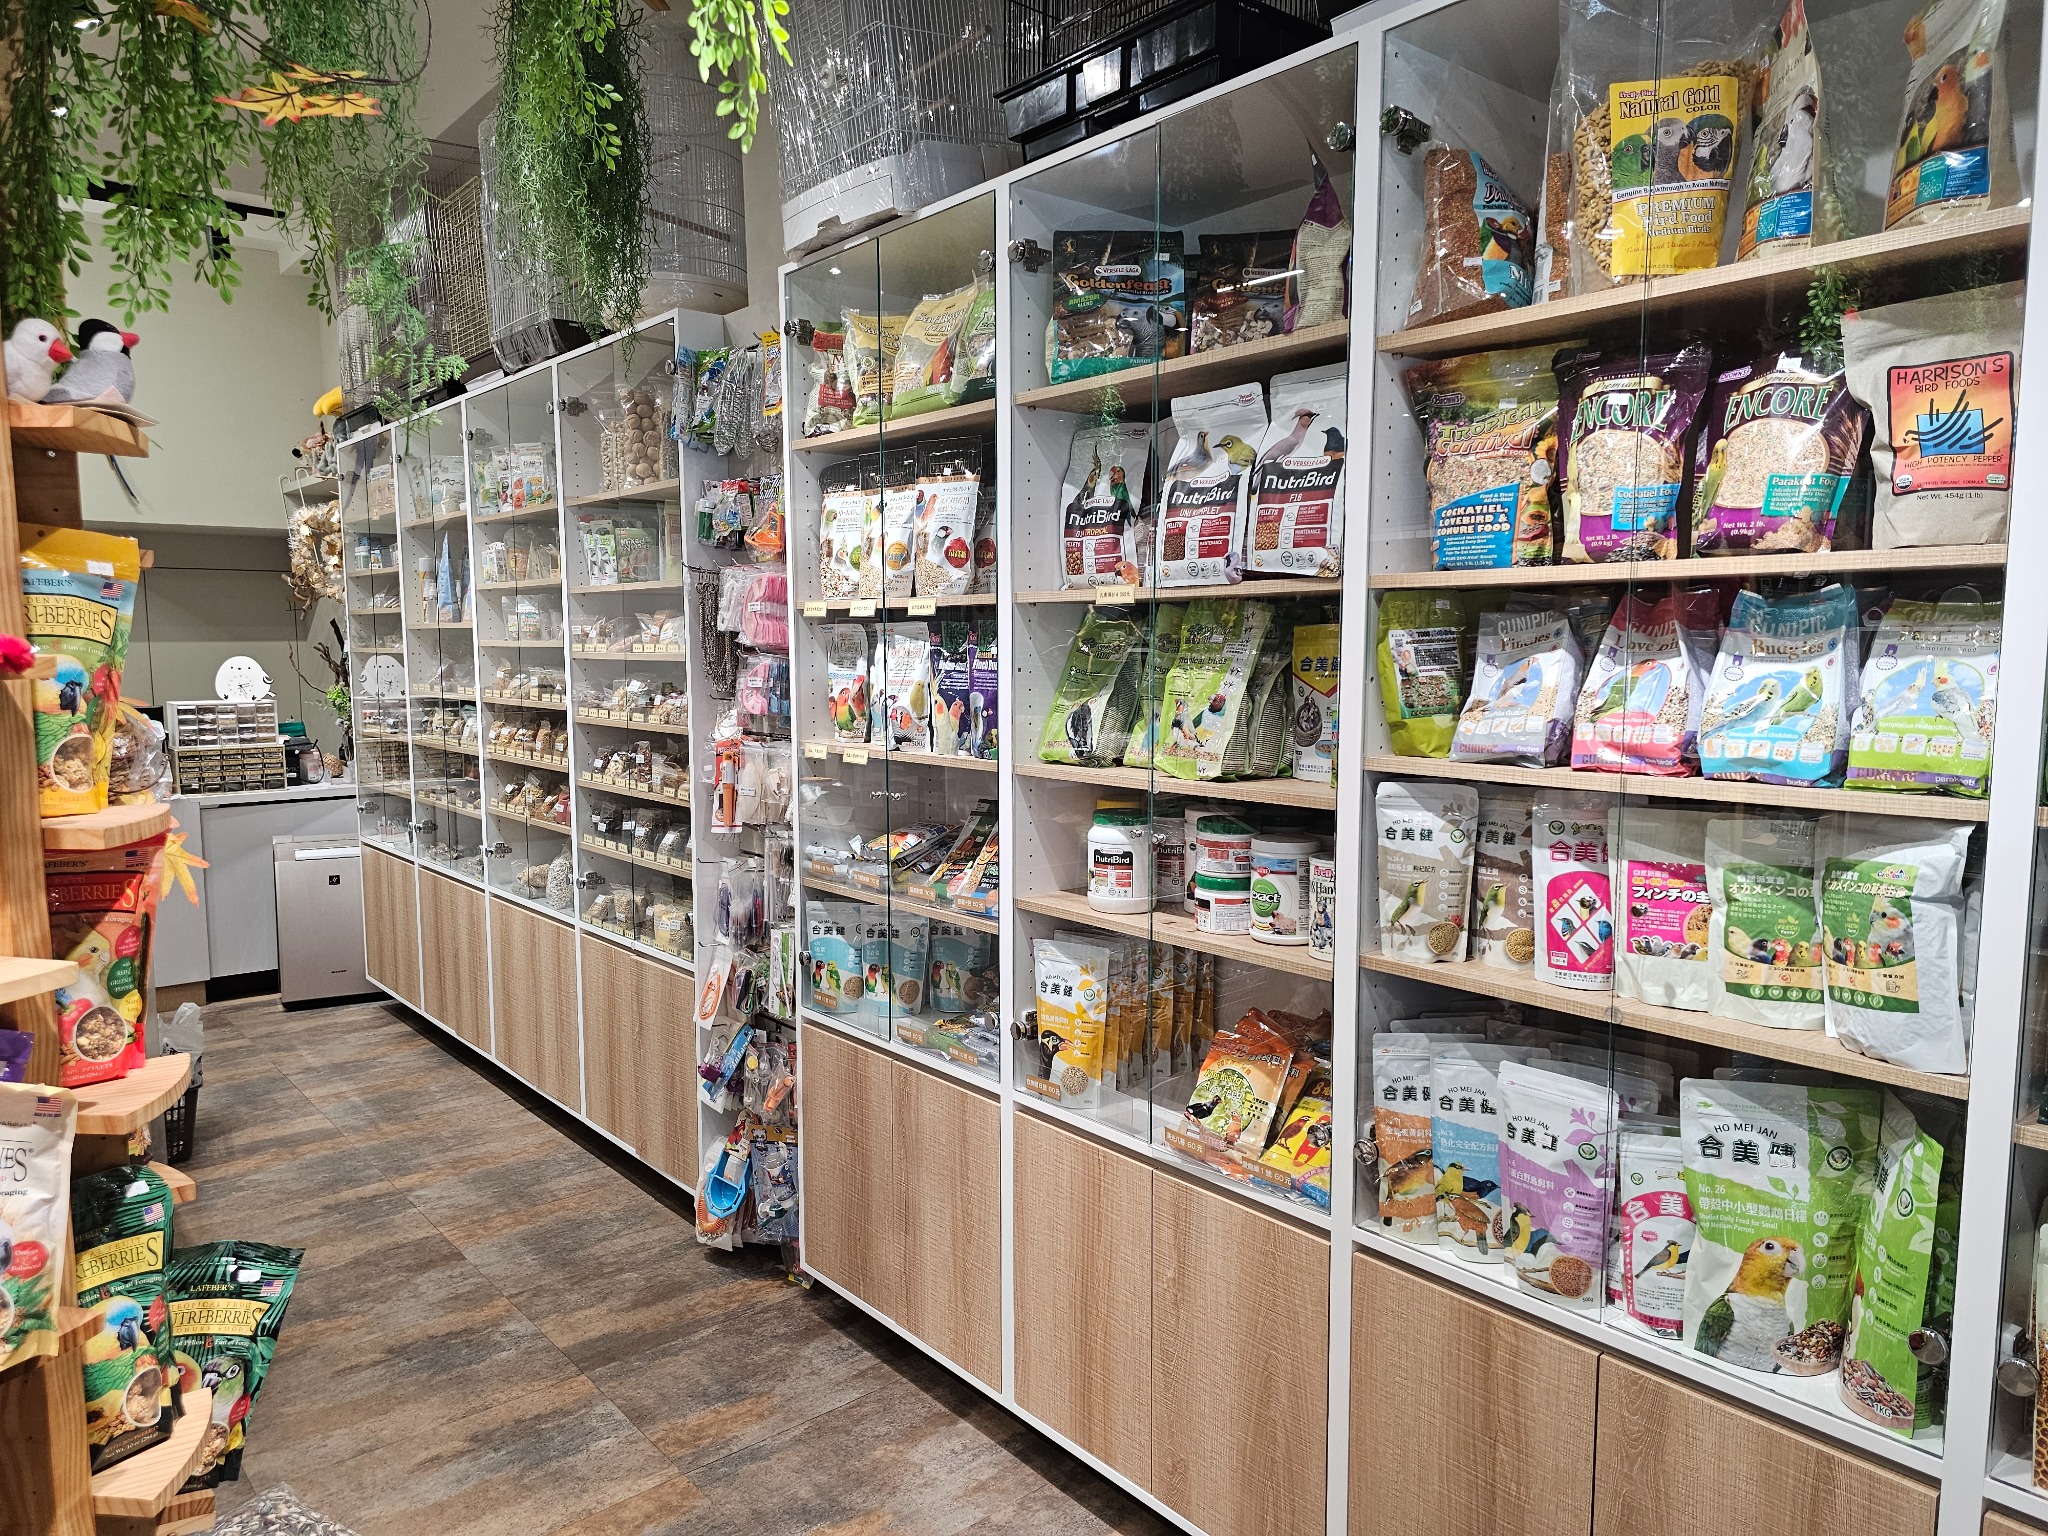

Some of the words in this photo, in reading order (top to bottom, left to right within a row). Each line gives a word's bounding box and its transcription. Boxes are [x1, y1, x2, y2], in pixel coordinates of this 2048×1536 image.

[1620, 91, 1679, 119] Natural
[1683, 85, 1720, 106] Gold
[1686, 105, 1720, 114] COLOR
[1616, 189, 1643, 200] Genuine
[1637, 197, 1715, 217] PREMIUM
[1681, 210, 1712, 223] Food
[1687, 224, 1711, 234] Birds
[1068, 293, 1101, 306] AMAZON
[1077, 300, 1094, 308] BLEND
[1896, 356, 2006, 386] HARRISON'S
[1915, 382, 1939, 394] BIRD
[1945, 376, 1981, 391] FOODS
[1570, 389, 1671, 445] ENCORE
[1723, 384, 1835, 436] ENCORE
[1439, 399, 1546, 441] TROPICAL
[1436, 424, 1537, 457] Carnival
[1510, 449, 1529, 457] FOOD
[1904, 459, 1923, 469] HIGH
[1927, 455, 1968, 464] POTENCY
[1973, 455, 2002, 463] PEPPER
[1263, 471, 1337, 490] NutriBird
[1771, 477, 1816, 487] Parakt
[1171, 486, 1236, 505] NutriBird
[1289, 493, 1303, 502] F16
[1617, 488, 1657, 499] Cocatiel
[1944, 492, 1964, 500] 454g
[1069, 509, 1122, 526] NutriBird
[1179, 508, 1192, 517] UNI
[1258, 508, 1279, 516] PELLETS
[1441, 503, 1509, 518] COCKATIEL,
[1439, 514, 1495, 527] LOVEBIRD
[1498, 513, 1509, 523] &
[1722, 521, 1735, 529] Net
[1756, 520, 1766, 528] lb.
[1085, 526, 1109, 537] TROPICAL
[1437, 525, 1475, 536] CONURE
[1477, 522, 1511, 533] FOOD
[22, 578, 74, 587] AFEBER'S
[27, 596, 50, 604] DEN
[54, 597, 93, 610] VEGGIE
[24, 605, 112, 640] RI-BERRIES
[1497, 610, 1554, 635] CUNIPIC
[66, 627, 97, 638] FOOD
[1751, 639, 1825, 660] Budgies
[1384, 825, 1435, 842] 合美健
[1157, 846, 1185, 855] NutriBi
[44, 860, 89, 868] AFEBER'S
[1095, 855, 1130, 864] NutriBird
[1251, 889, 1282, 904] exact
[1631, 886, 1712, 904] フィンチの主
[105, 915, 133, 924] Foraging
[812, 925, 846, 936] 合美健
[1473, 1087, 1488, 1098] JAN
[1511, 1114, 1523, 1122] HO
[1523, 1114, 1537, 1124] MEI
[1537, 1119, 1550, 1131] JAN
[1713, 1123, 1731, 1134] HO
[1733, 1123, 1754, 1133] MEI
[1756, 1125, 1779, 1140] JAN
[1186, 1140, 1204, 1154] 60元
[1274, 1174, 1292, 1187] 60元
[1698, 1183, 1713, 1194] No.
[1714, 1184, 1726, 1195] 26
[1719, 1214, 1735, 1224] Daily
[1736, 1216, 1750, 1226] Feed
[1750, 1217, 1761, 1227] for
[1761, 1219, 1778, 1230] Small
[108, 1237, 142, 1251] FRUIT
[14, 1248, 39, 1257] Omega
[76, 1236, 159, 1280] RI-BERRIES
[11, 1262, 42, 1272] Balanced
[79, 1293, 101, 1306] Pellets
[110, 1284, 125, 1293] Fun
[125, 1280, 134, 1288] of
[134, 1275, 163, 1286] Foraging
[190, 1283, 237, 1292] LAFEBER'S
[171, 1302, 221, 1311] TROPICAL
[226, 1301, 253, 1309] FRUIT
[172, 1308, 260, 1332] UTRI-BERRIES
[1873, 1402, 1893, 1419] 1KG
